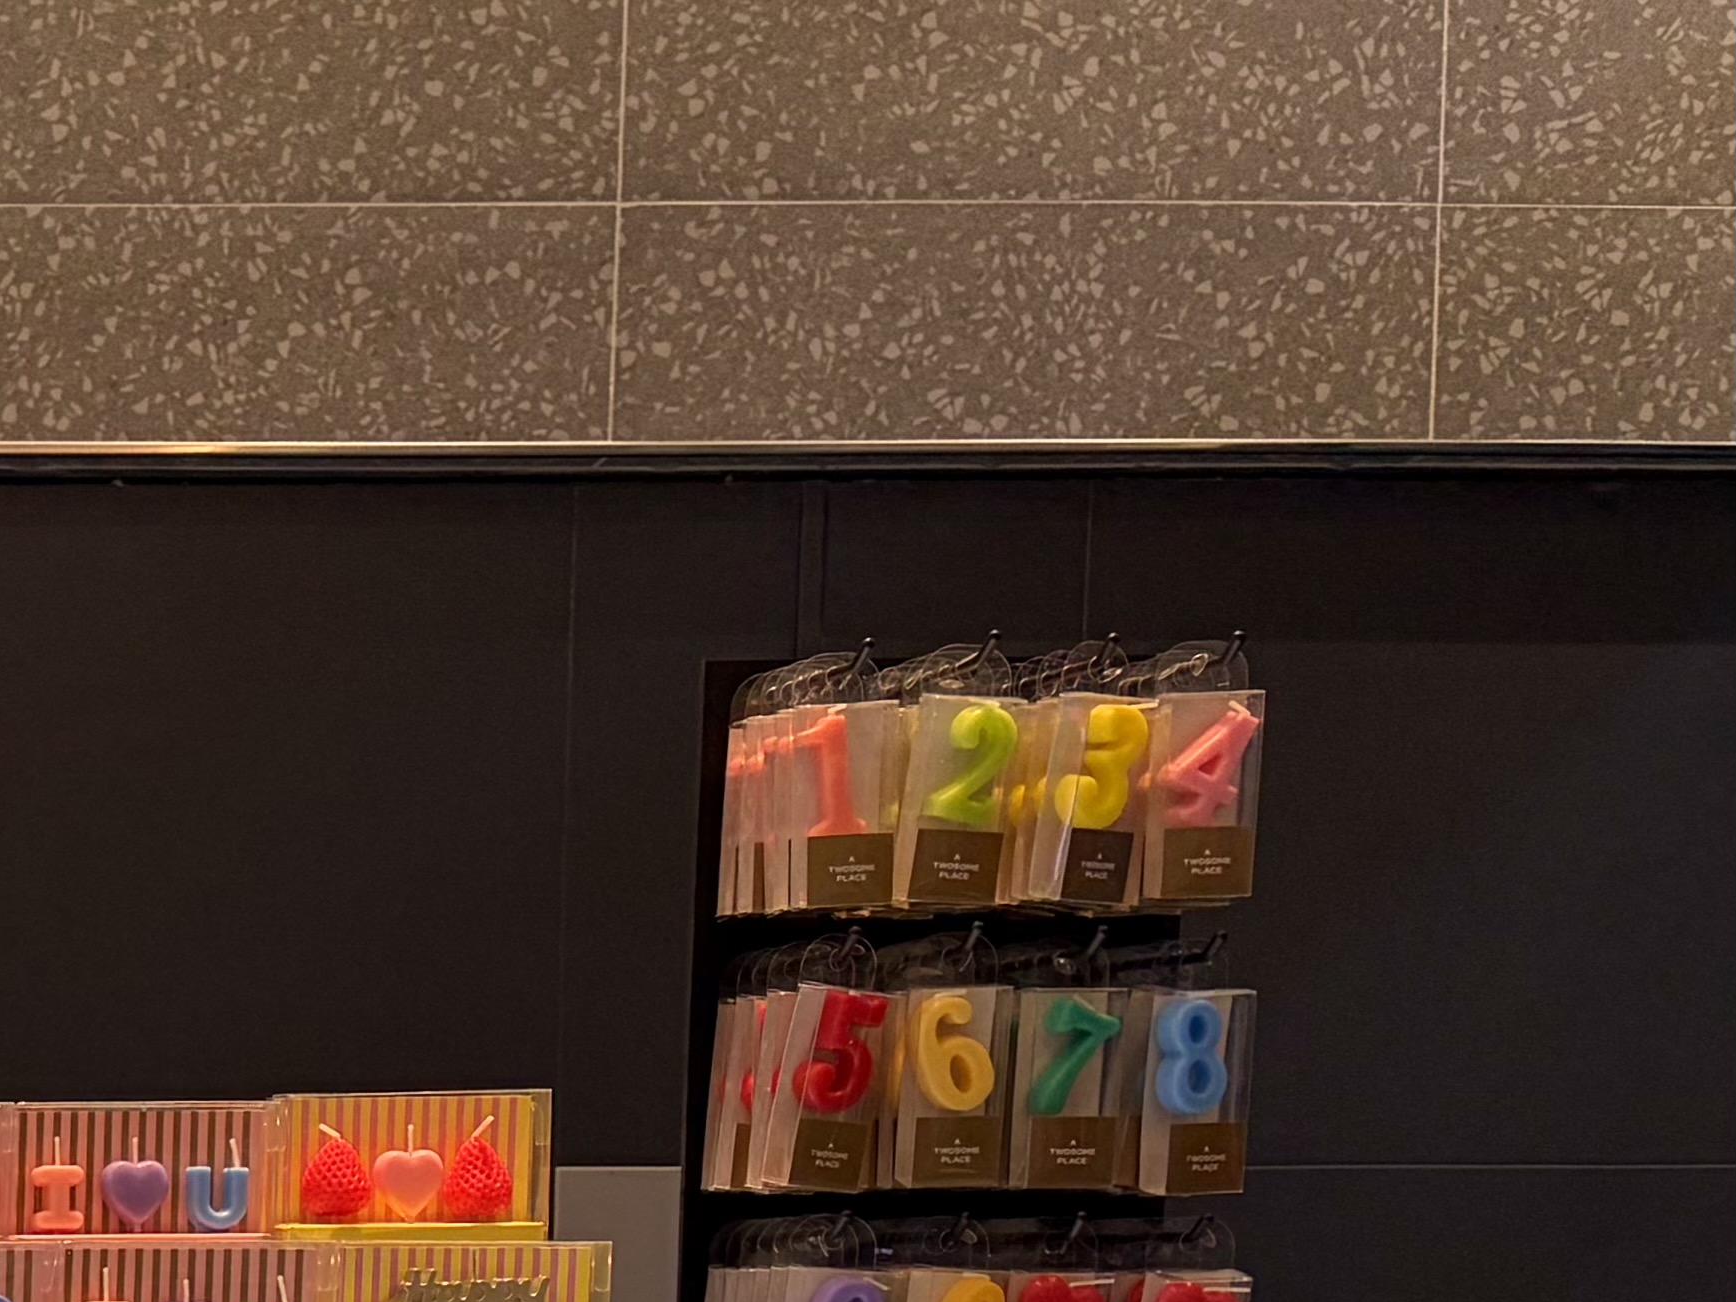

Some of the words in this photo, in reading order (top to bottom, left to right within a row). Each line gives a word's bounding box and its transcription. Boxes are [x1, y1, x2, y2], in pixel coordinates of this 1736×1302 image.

[807, 713, 866, 837] 1
[929, 706, 1017, 824] 2
[1056, 704, 1148, 829] 3
[1166, 708, 1260, 825] 4
[792, 990, 887, 1113] 5
[916, 997, 994, 1111] 6
[1029, 996, 1122, 1115] 7
[1156, 999, 1228, 1114] 8
